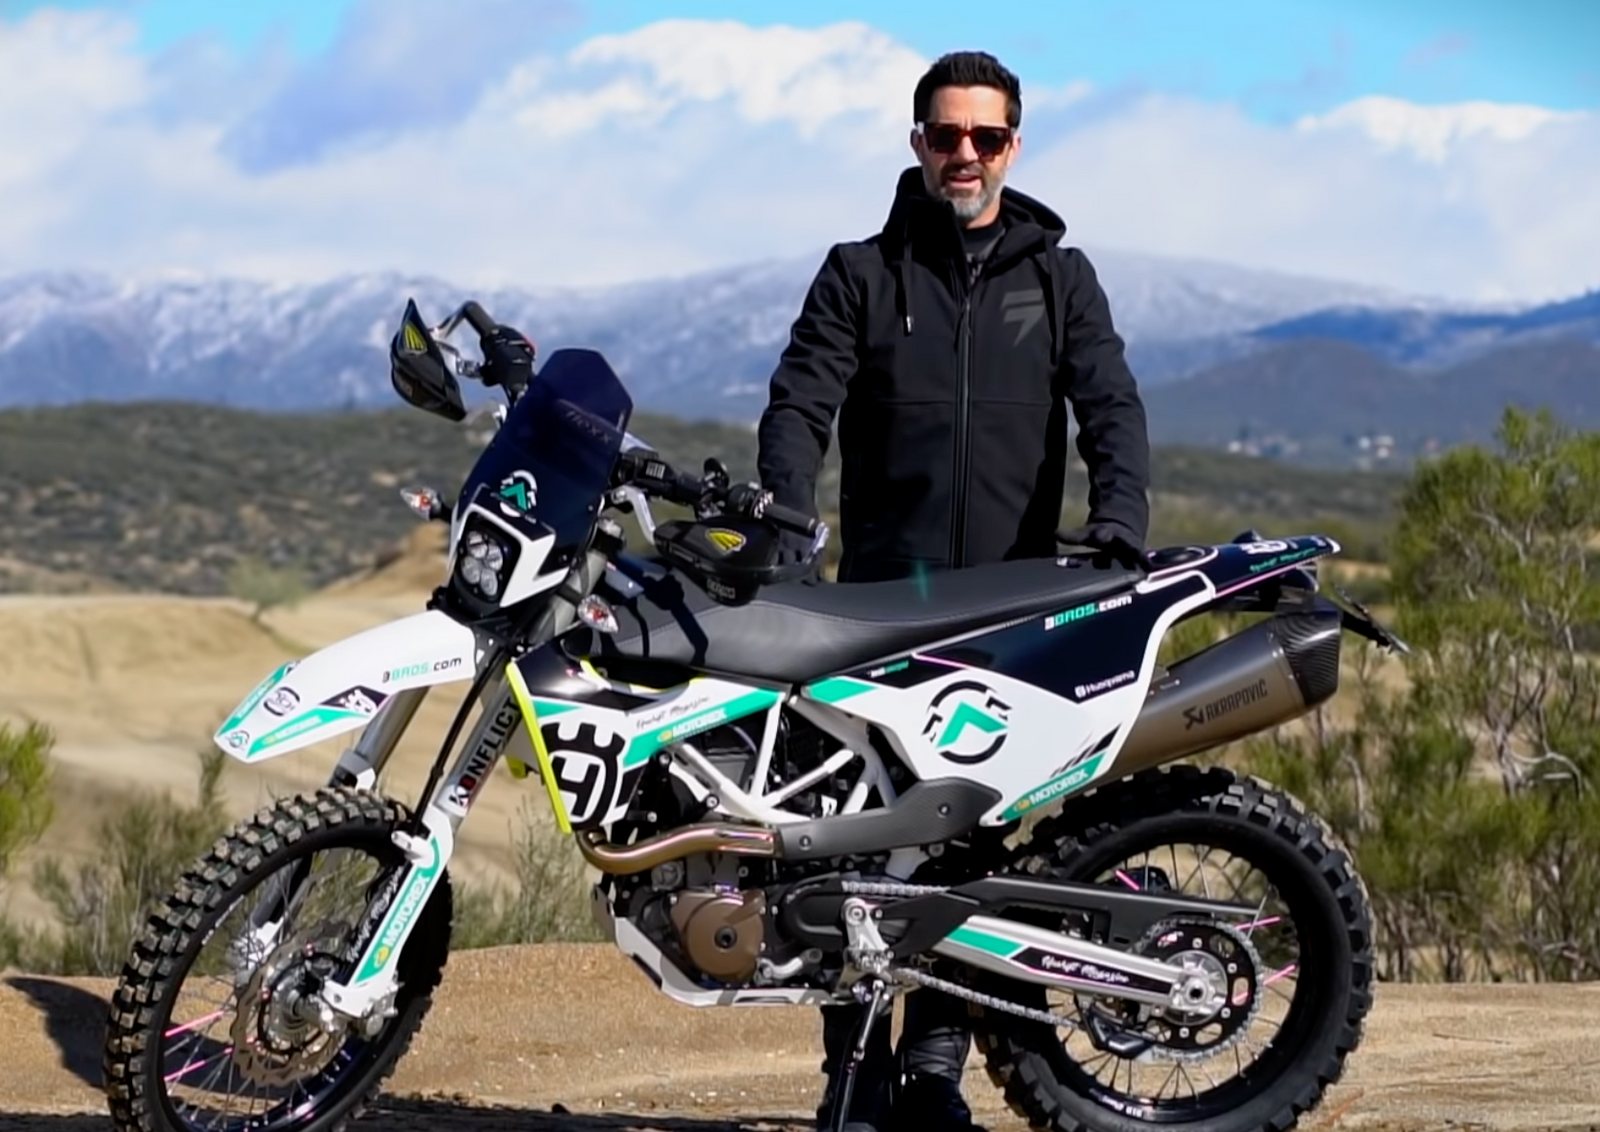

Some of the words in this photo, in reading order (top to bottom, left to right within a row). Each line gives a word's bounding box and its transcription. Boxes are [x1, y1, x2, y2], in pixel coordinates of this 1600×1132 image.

[448, 696, 520, 806] KONFLICT
[1029, 768, 1089, 805] MOTOREX
[383, 874, 431, 946] MOTOREX
